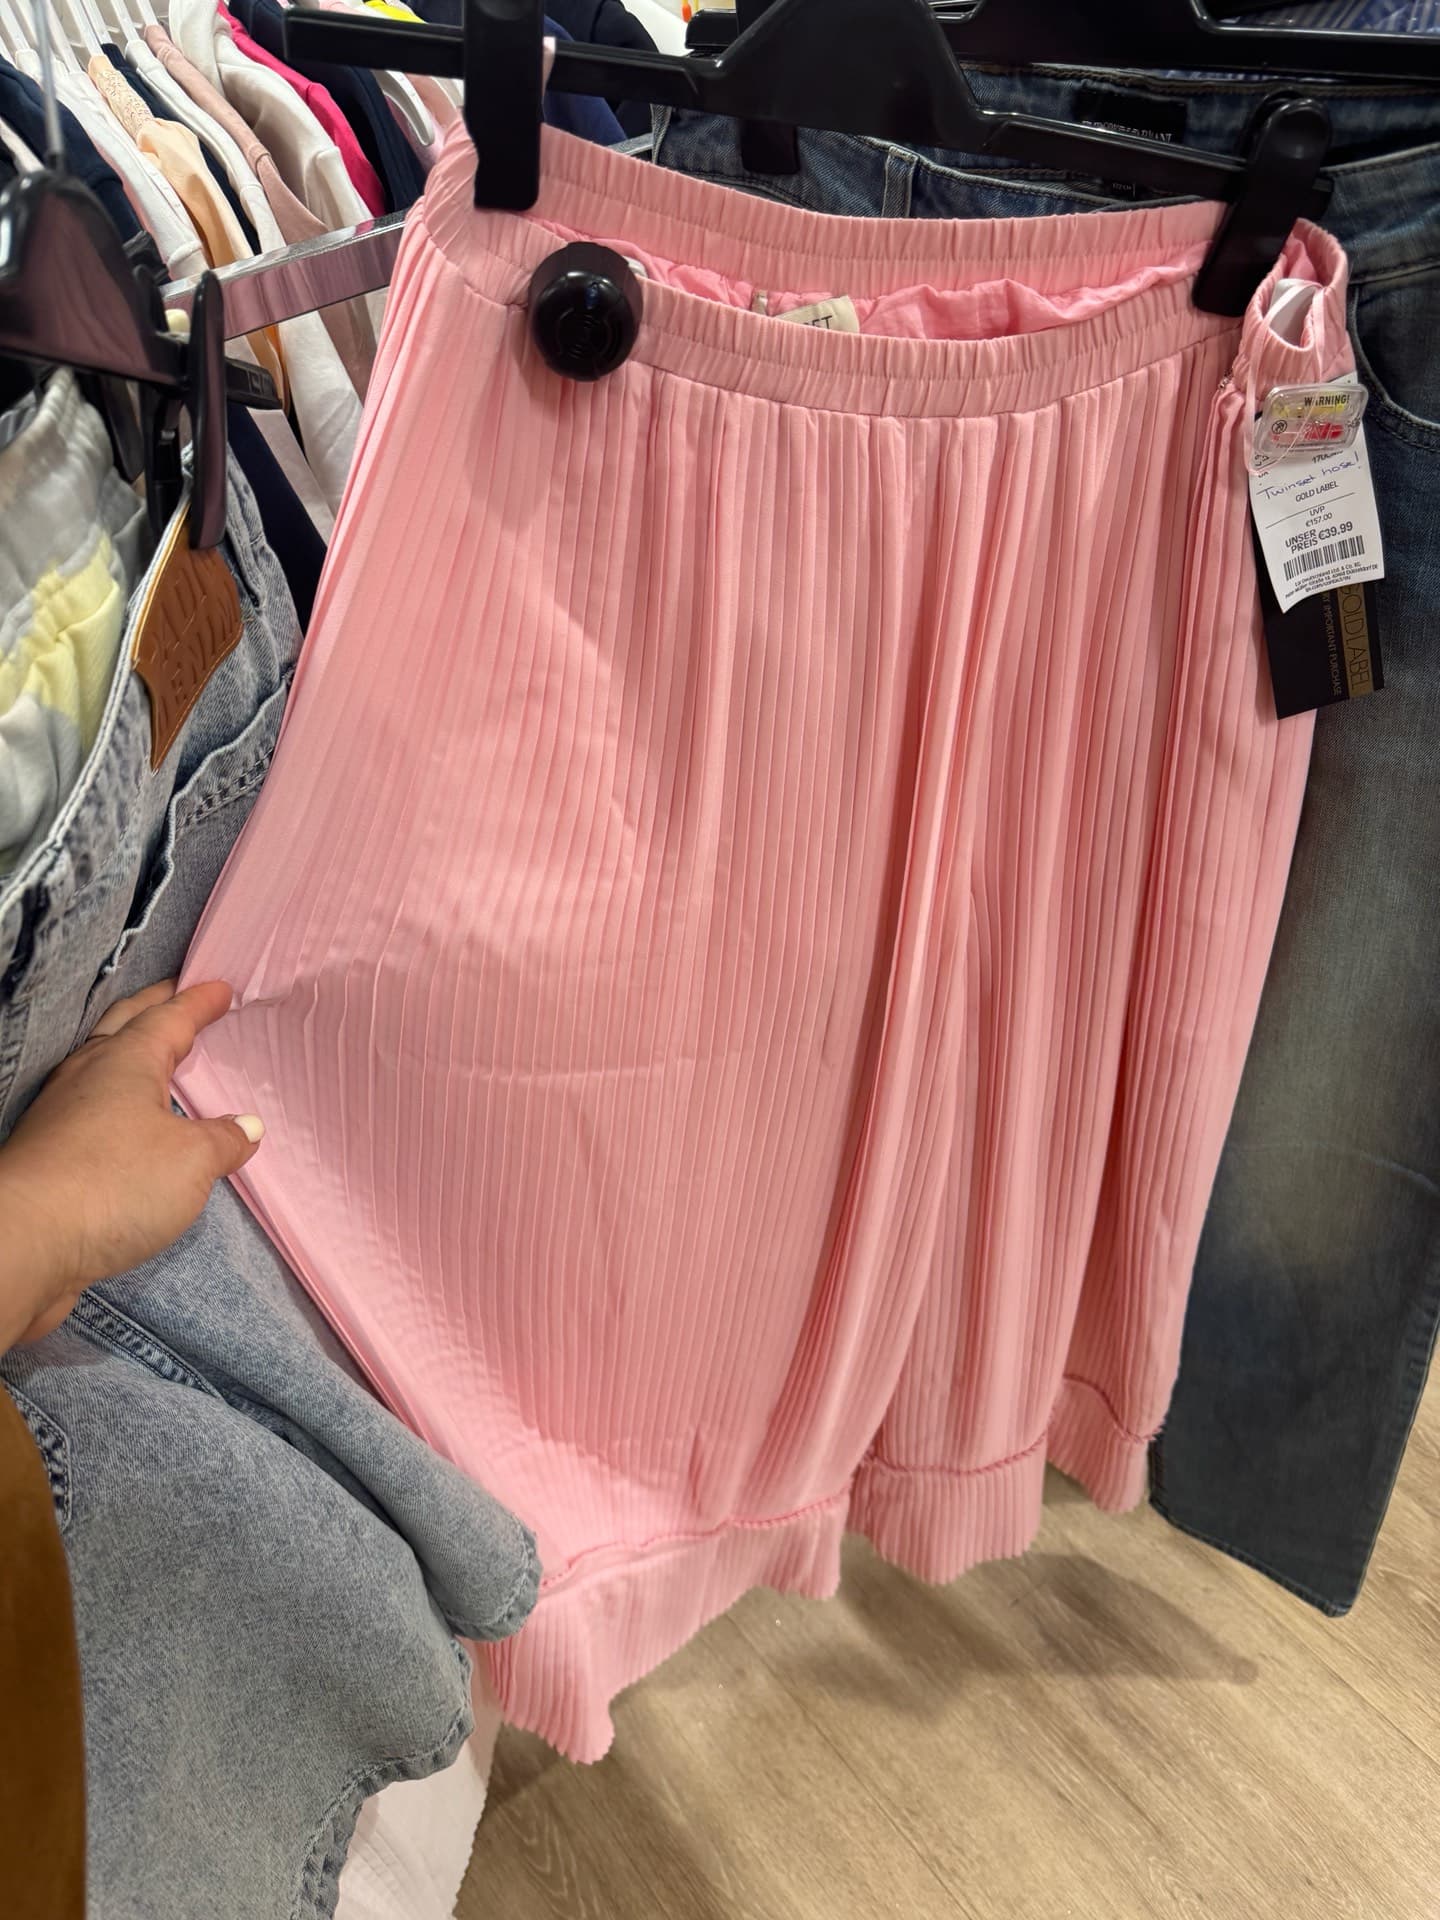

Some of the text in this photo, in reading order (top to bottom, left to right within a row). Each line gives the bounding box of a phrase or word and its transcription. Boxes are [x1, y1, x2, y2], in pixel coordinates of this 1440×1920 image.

[1256, 475, 1316, 500] Twinset
[1295, 481, 1339, 502] GOLD LABEL
[1305, 513, 1333, 527] €157.00
[1309, 505, 1325, 517] UVP
[1285, 529, 1317, 548] UNSER
[1318, 521, 1353, 540] €39.99
[1291, 537, 1318, 554] PREIS
